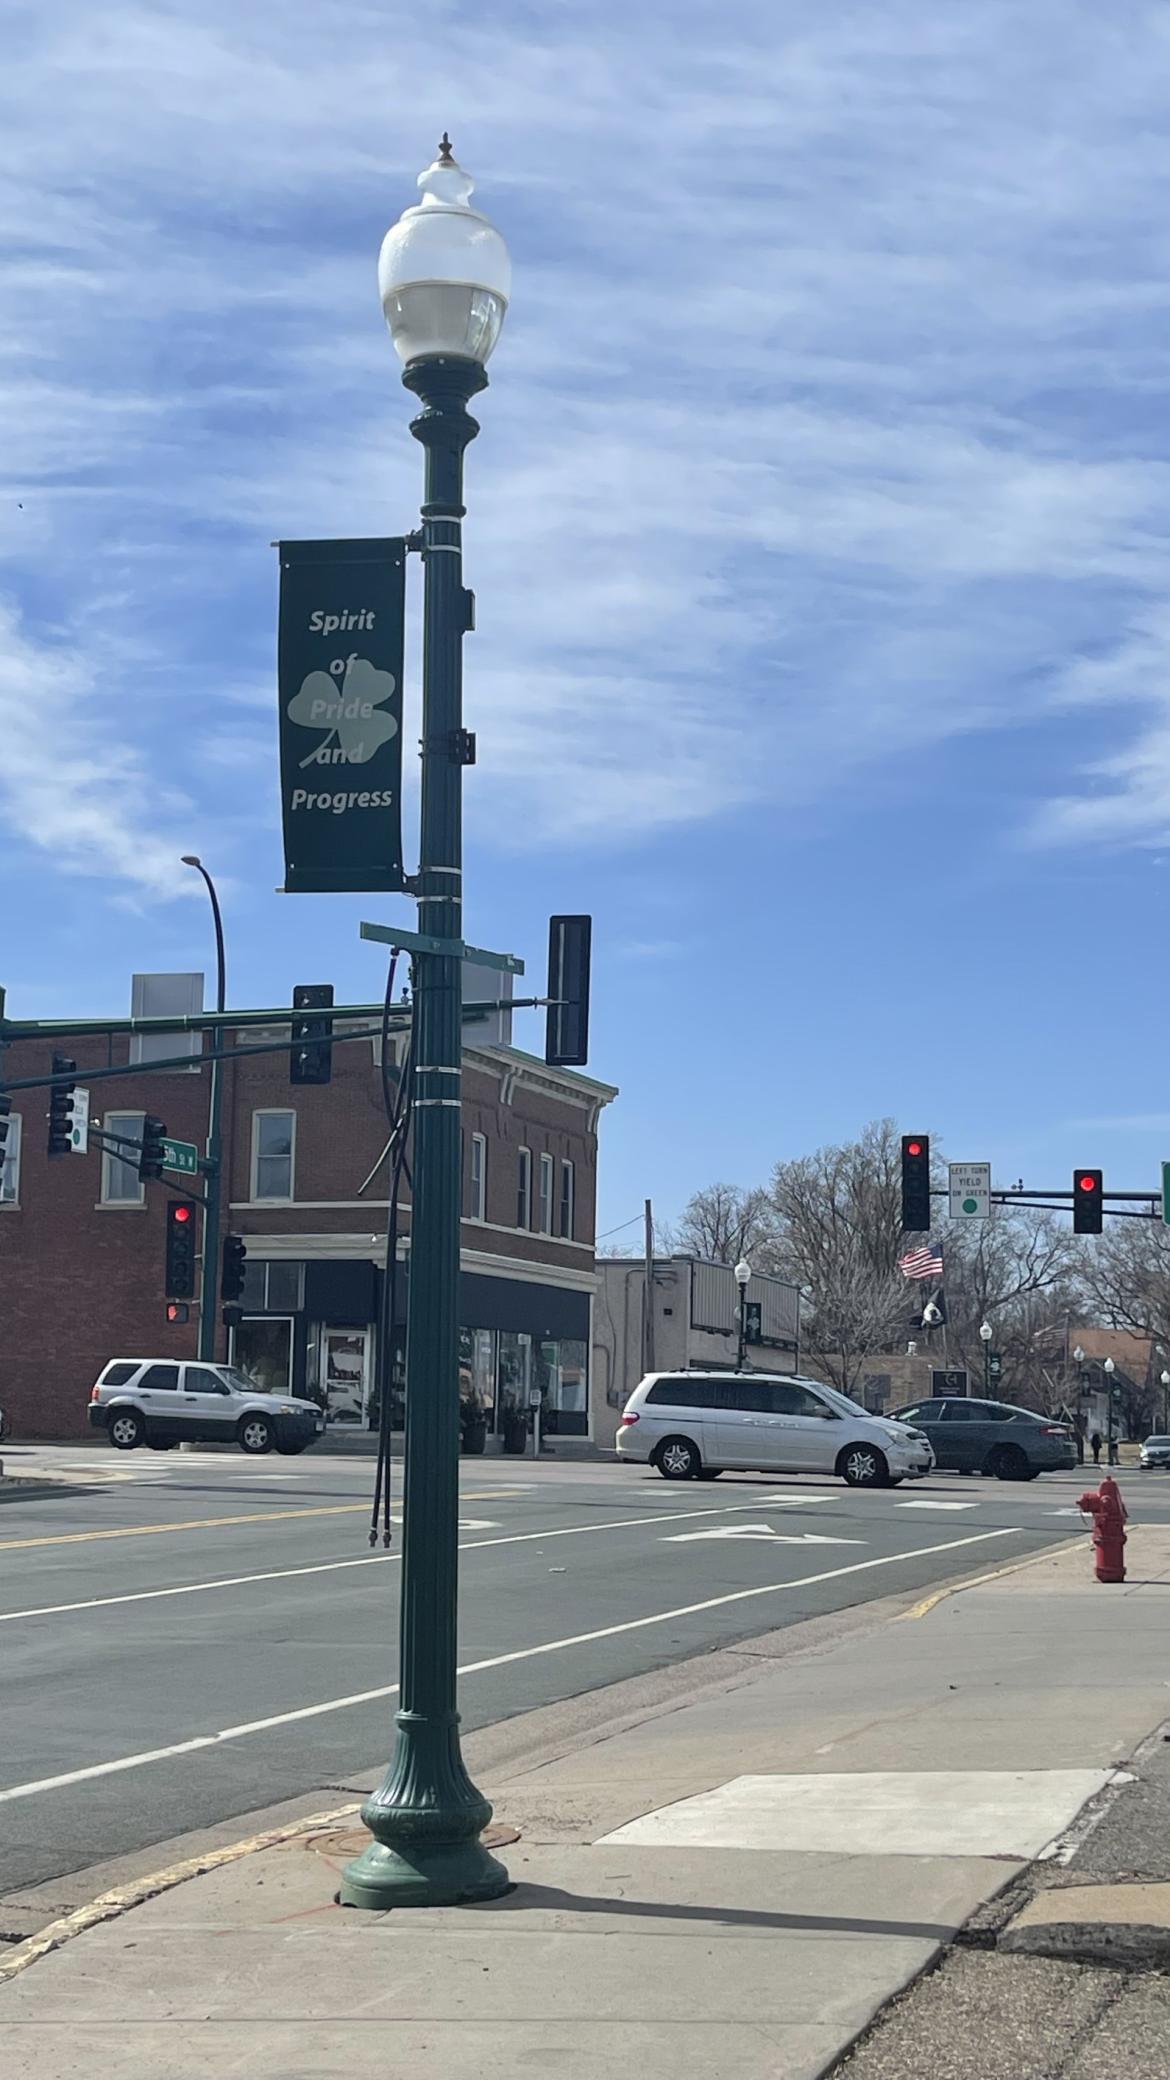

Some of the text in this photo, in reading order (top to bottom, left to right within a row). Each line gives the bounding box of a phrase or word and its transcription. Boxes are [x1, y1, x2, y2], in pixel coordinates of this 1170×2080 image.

[309, 609, 375, 636] Spirit
[329, 653, 358, 675] of
[310, 698, 374, 721] Pride
[316, 741, 364, 764] and
[291, 789, 393, 814] Progress
[951, 1167, 967, 1175] LEFT
[959, 1177, 981, 1187] YIELD
[965, 1189, 988, 1197] GREEN
